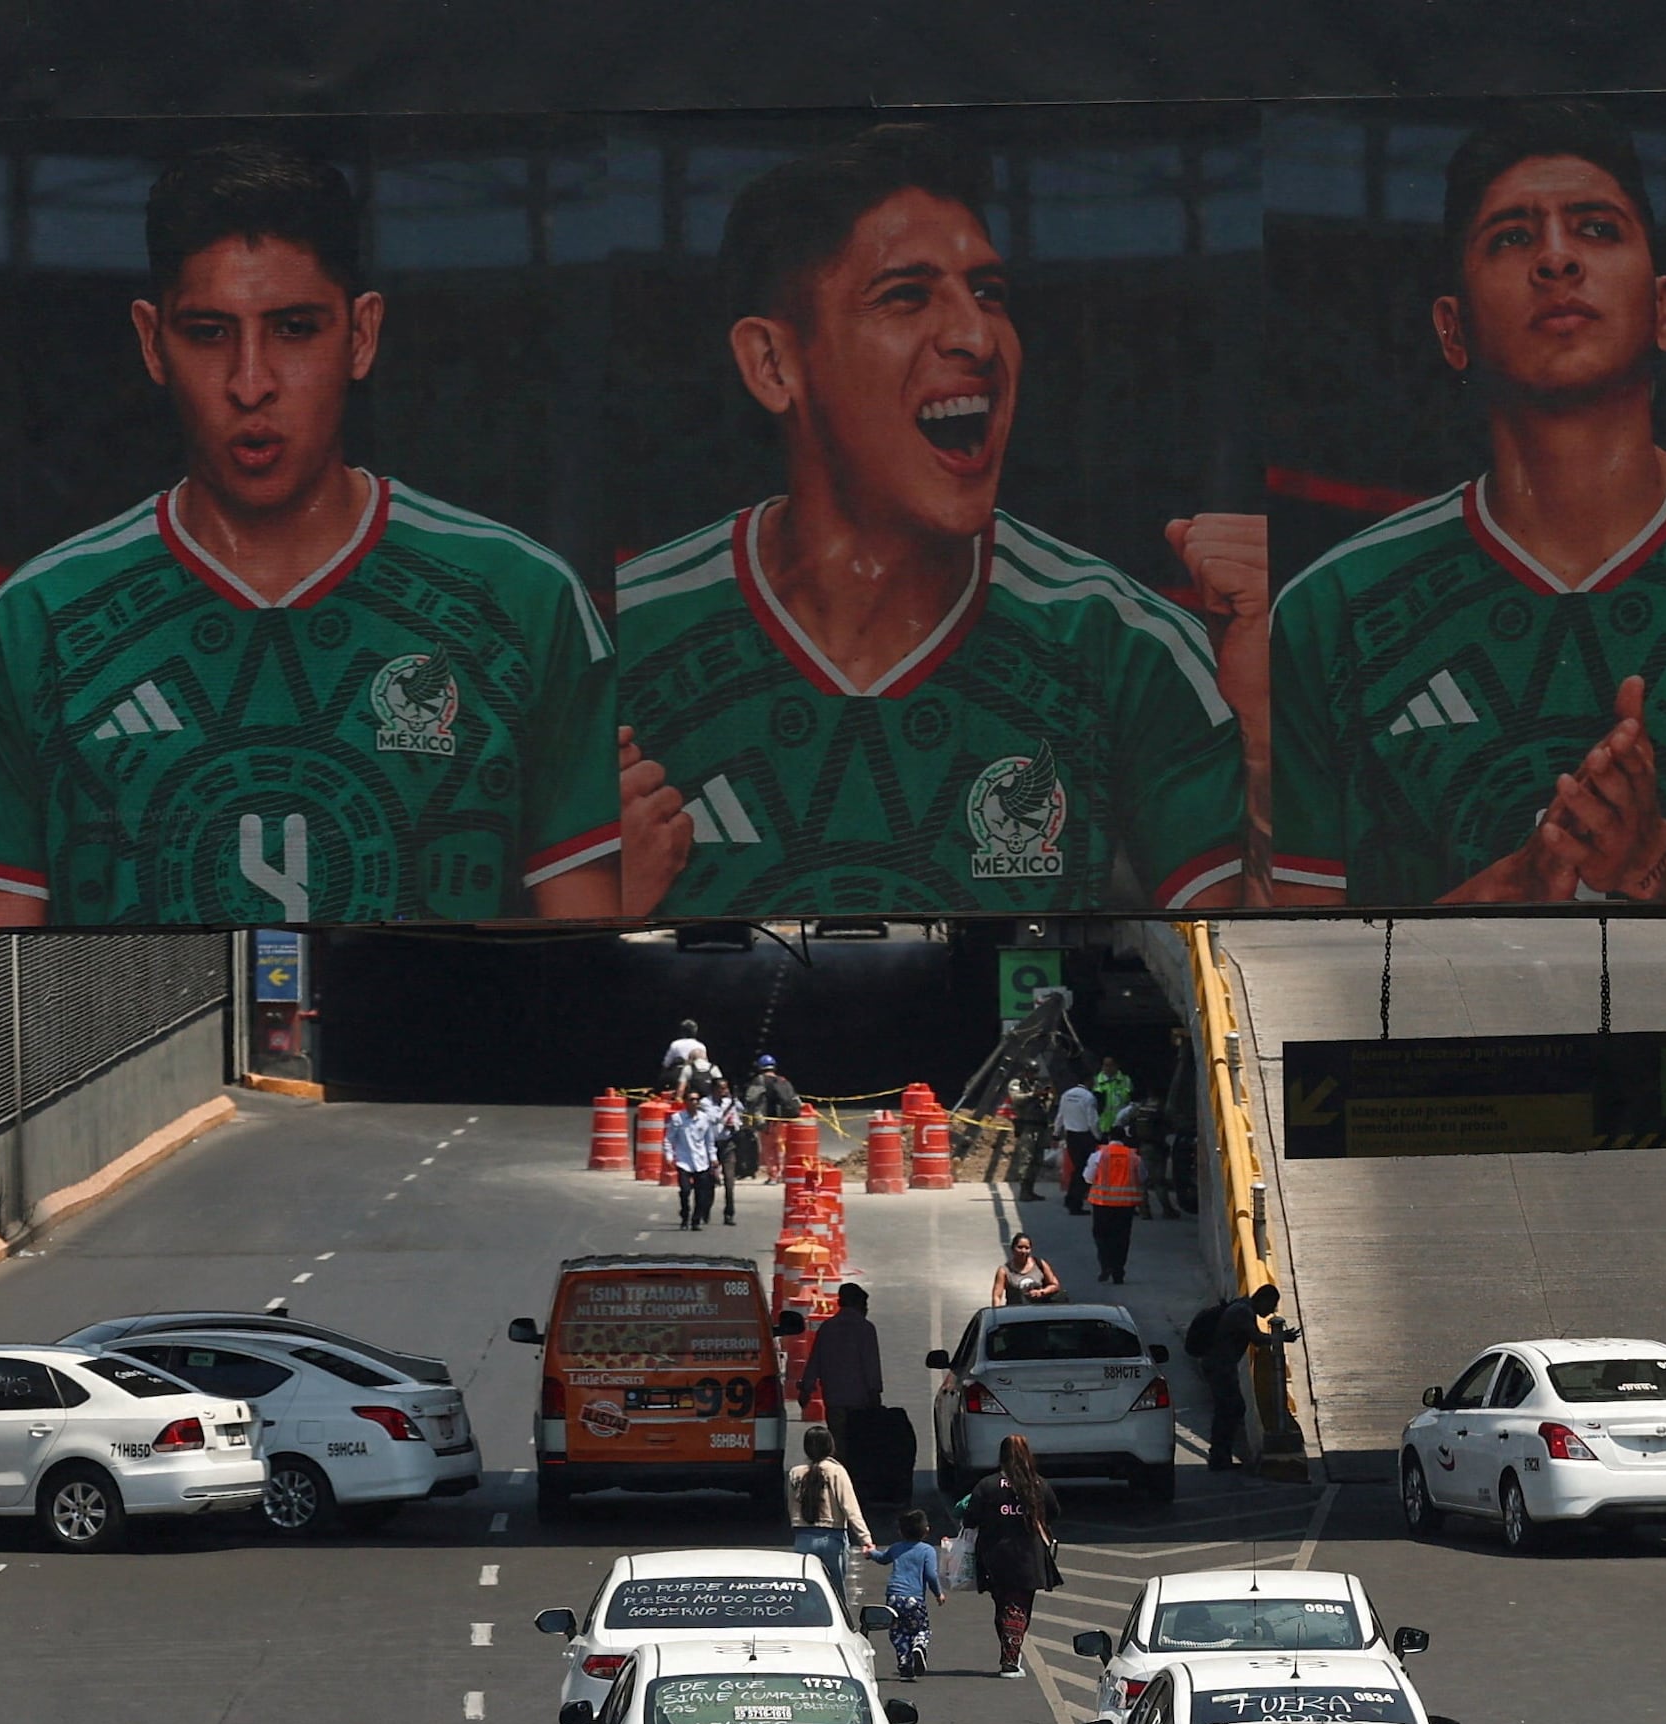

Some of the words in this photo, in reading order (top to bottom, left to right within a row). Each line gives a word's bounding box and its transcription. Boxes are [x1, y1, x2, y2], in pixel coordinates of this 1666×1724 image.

[378, 731, 455, 754] MÉXICO
[974, 855, 1062, 876] MÉXICO
[624, 1285, 706, 1303] TRAMPAS
[110, 1442, 151, 1459] 71HB5D
[771, 1582, 807, 1593] 1473
[623, 1595, 687, 1607] PUEBLO
[693, 1594, 747, 1605] MUDO
[752, 1595, 793, 1604] CON
[628, 1606, 718, 1618] GOBIERNO
[724, 1605, 795, 1617] SORDO
[1304, 1603, 1345, 1616] 0956
[801, 1677, 844, 1690] 1737
[1353, 1691, 1396, 1704] 0834
[1230, 1693, 1354, 1716] FUERA
